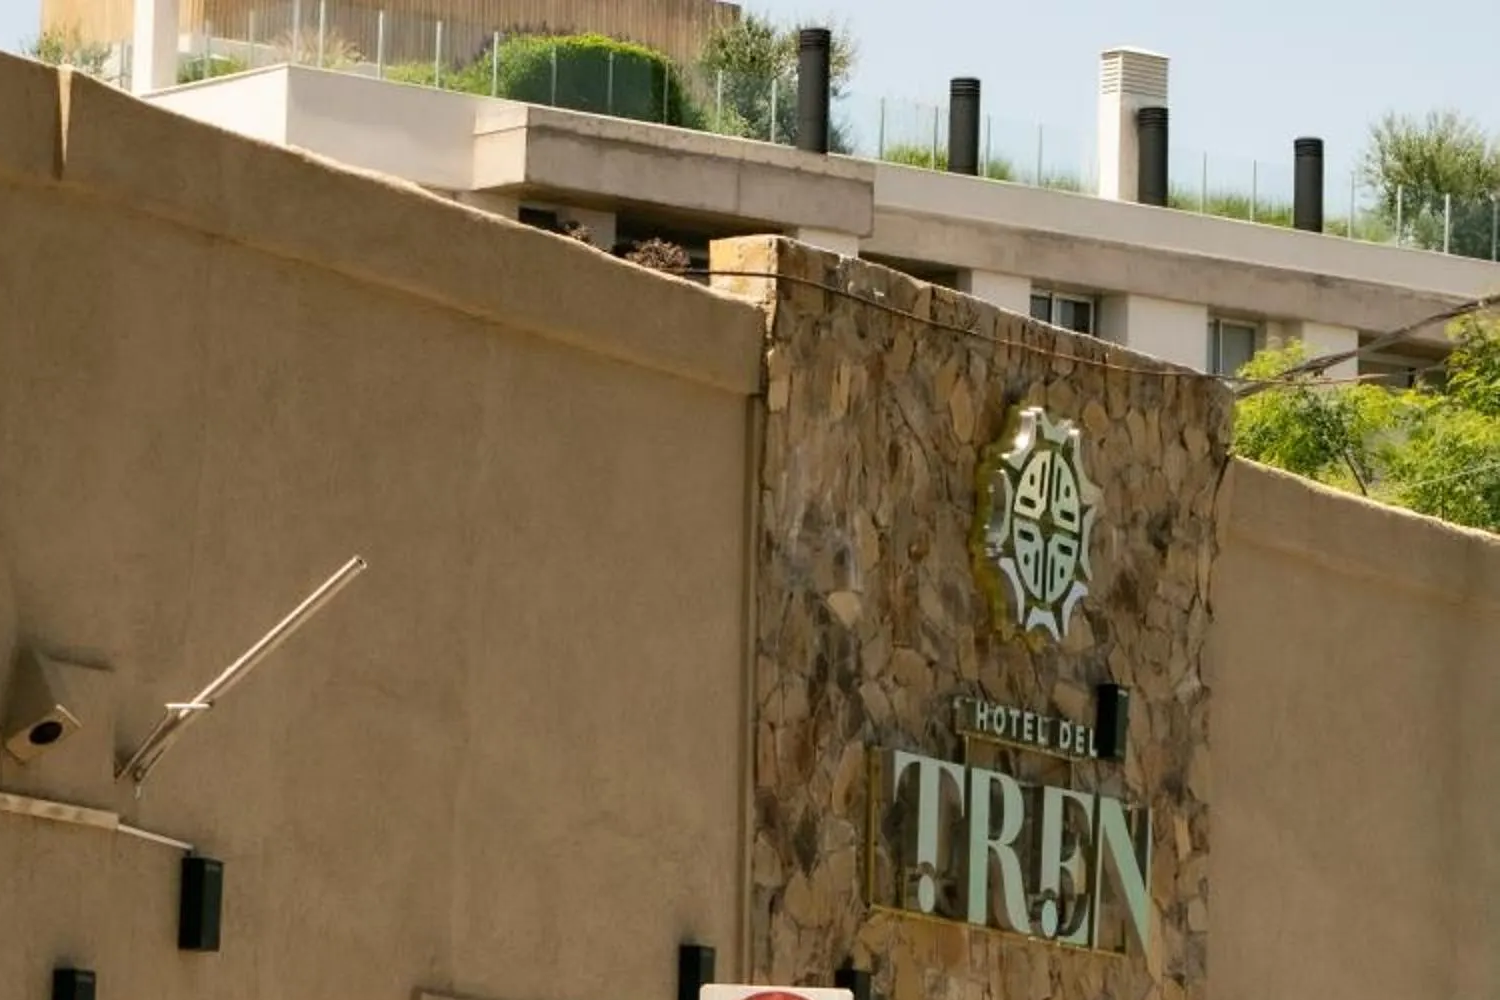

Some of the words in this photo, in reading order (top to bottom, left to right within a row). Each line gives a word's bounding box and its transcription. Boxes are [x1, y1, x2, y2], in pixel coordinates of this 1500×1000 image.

[976, 700, 1049, 746] HOTEL
[1059, 720, 1098, 758] DEL
[893, 750, 1161, 978] TREN
